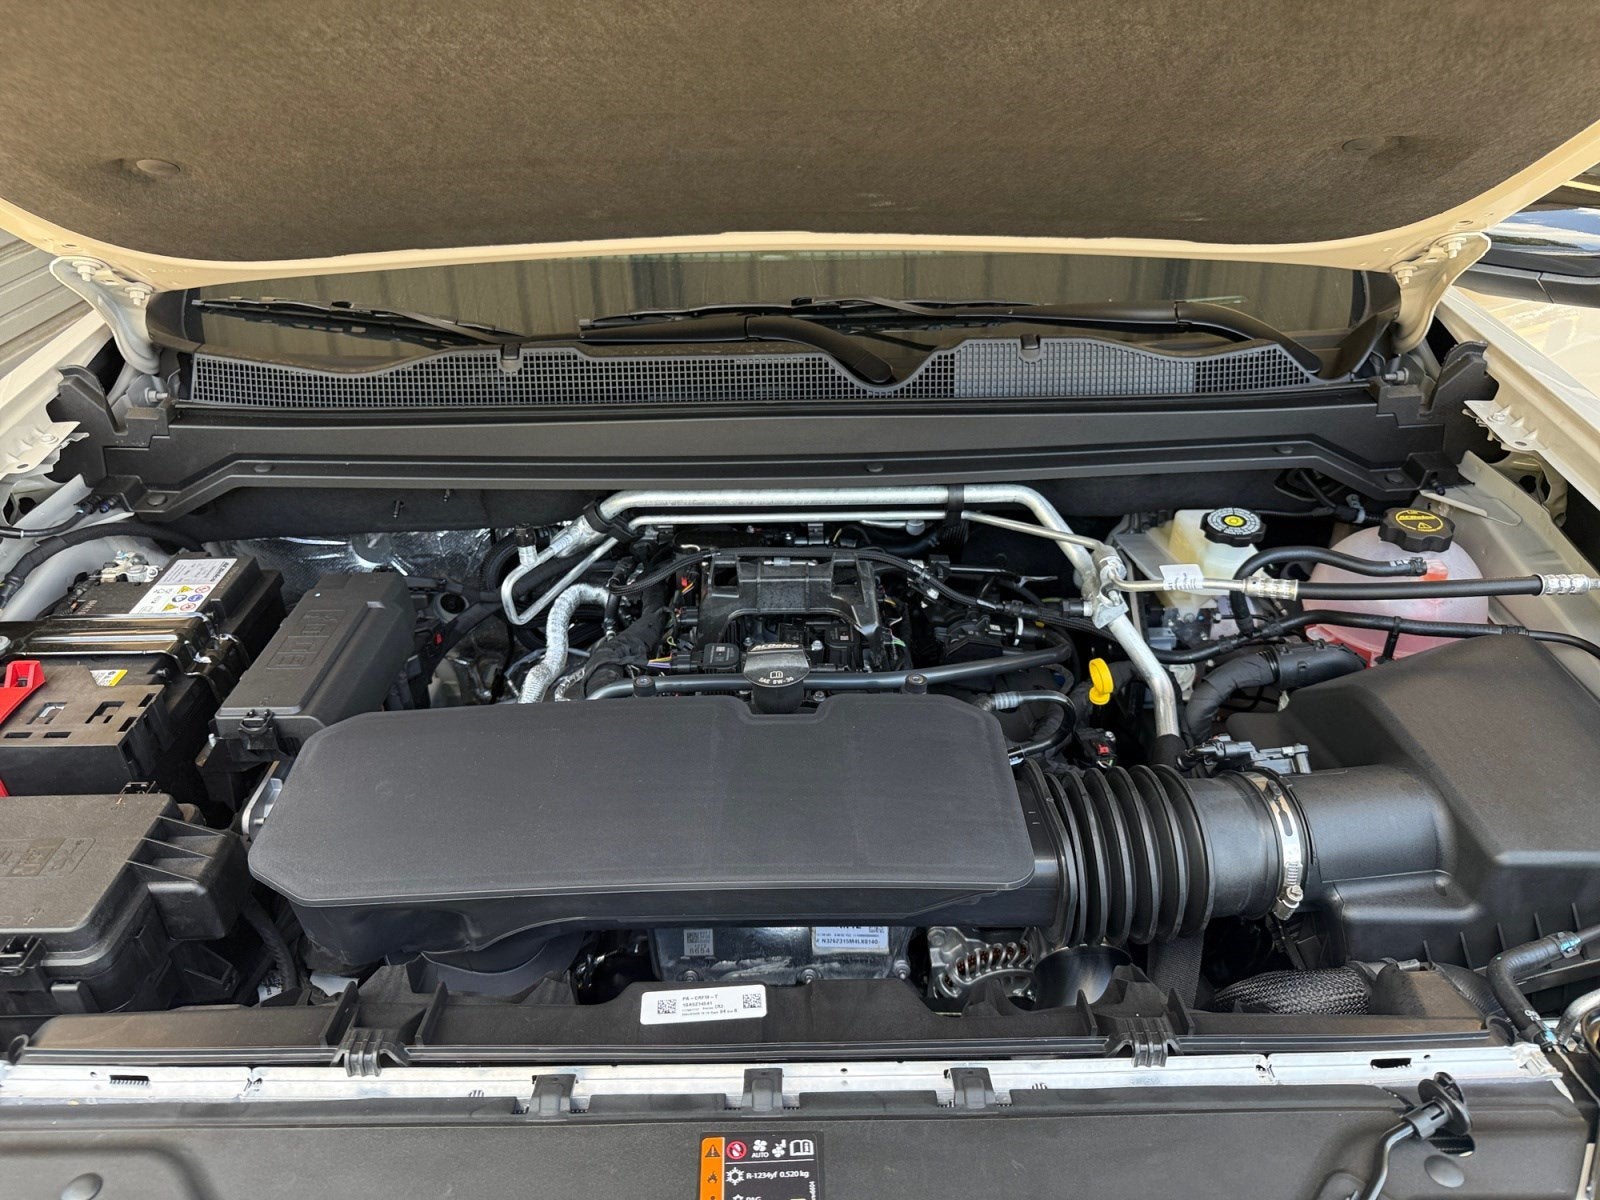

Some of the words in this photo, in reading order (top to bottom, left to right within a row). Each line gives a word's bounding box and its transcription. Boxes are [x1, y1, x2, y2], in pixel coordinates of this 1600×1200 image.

[746, 1171, 778, 1180] R-1234yf
[779, 1170, 800, 1178] 0.520
[800, 1170, 810, 1179] kg
